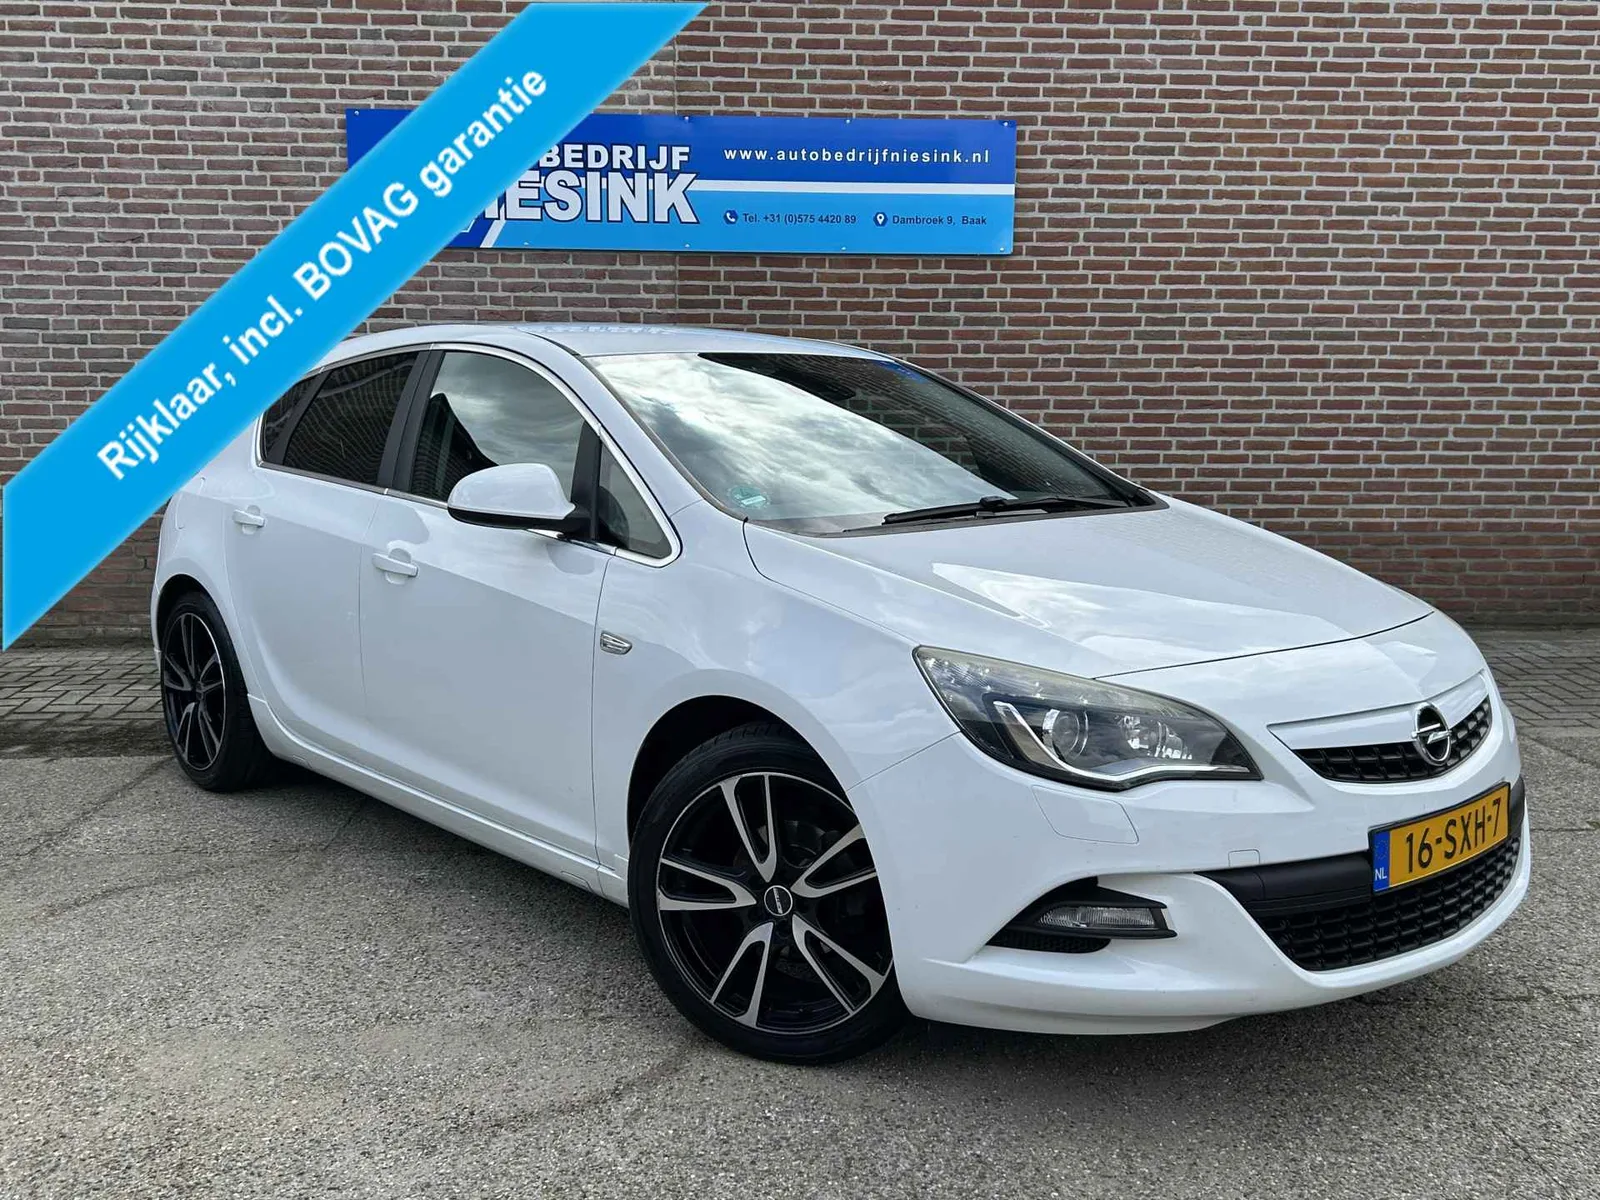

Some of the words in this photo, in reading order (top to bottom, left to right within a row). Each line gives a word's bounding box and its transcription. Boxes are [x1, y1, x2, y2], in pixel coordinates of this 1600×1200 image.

[724, 148, 989, 165] www.autobedrijfniesink.nl
[742, 212, 761, 223] Tel.
[763, 213, 781, 223] +31
[784, 213, 815, 225] (0)575
[818, 214, 842, 224] 4420
[845, 214, 857, 224] 89
[892, 214, 943, 225] Dambroek
[946, 215, 956, 226] 9,
[961, 215, 987, 225] Baak
[1405, 797, 1502, 874] 16-SXH-7
[1374, 867, 1388, 881] NL
